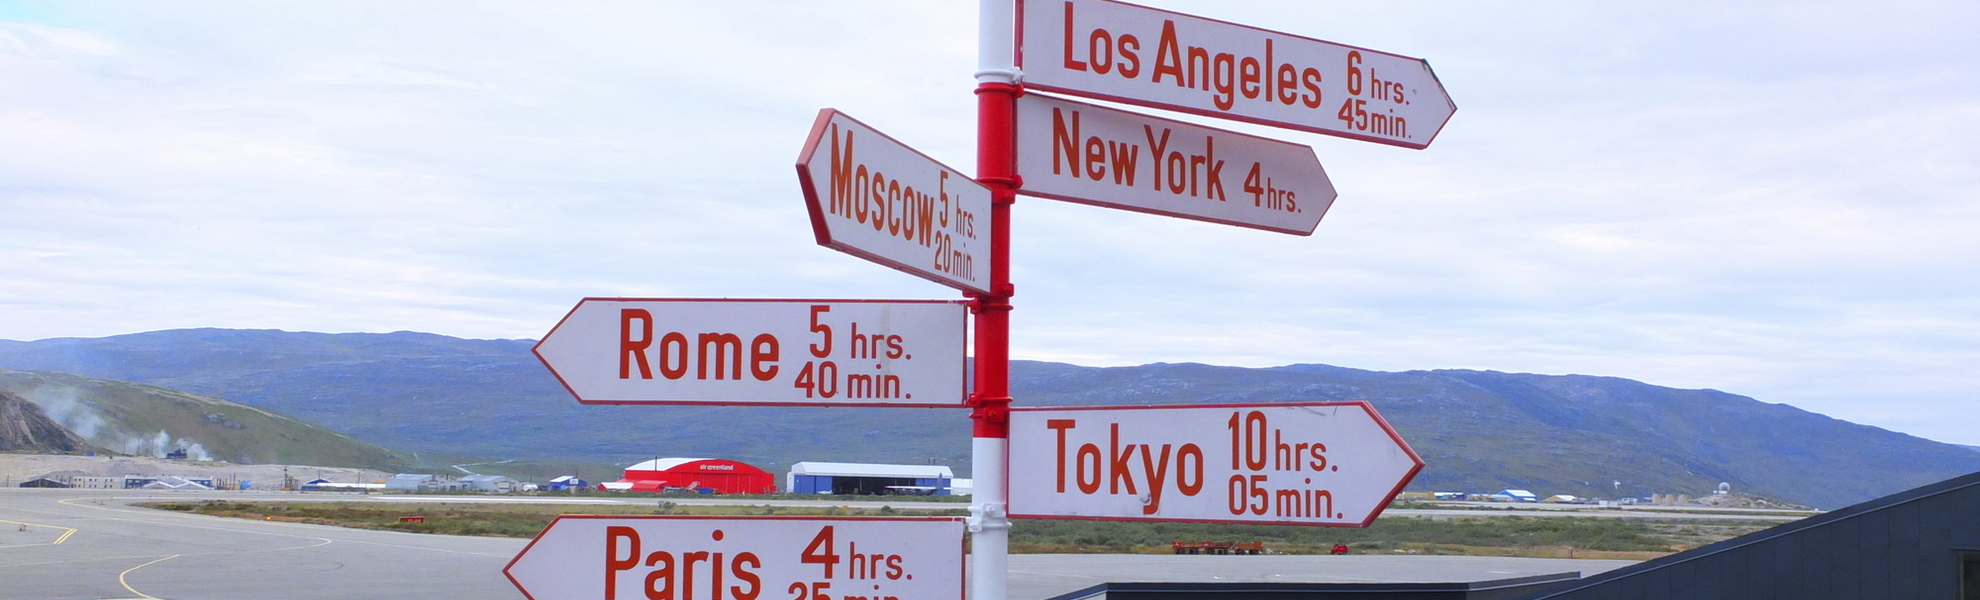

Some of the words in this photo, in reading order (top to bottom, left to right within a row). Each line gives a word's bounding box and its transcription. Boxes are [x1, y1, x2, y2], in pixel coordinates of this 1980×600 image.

[1064, 2, 1140, 79] Los
[1152, 20, 1322, 111] Angeles
[1347, 50, 1362, 96] 6
[1371, 67, 1410, 105] hrs.
[1337, 98, 1368, 131] 45
[1371, 108, 1411, 139] min.
[1053, 108, 1138, 187] New
[1144, 125, 1226, 202] York
[830, 122, 935, 248] Moscow
[939, 169, 949, 228] 5
[955, 194, 976, 240] hrs.
[1244, 162, 1264, 207] 4
[1267, 177, 1302, 213] hrs.
[934, 230, 951, 273] 20
[952, 242, 976, 282] min.
[619, 308, 780, 381] Rome
[809, 305, 832, 358] 5
[850, 322, 912, 360] hrs.
[794, 361, 837, 399] 40
[847, 363, 912, 400] min.
[1047, 419, 1204, 515] Tokyo
[1228, 410, 1267, 471] 10
[1275, 429, 1338, 472] hrs.
[1228, 474, 1269, 515] 05
[1275, 478, 1344, 519] min.
[605, 525, 761, 600] Paris
[801, 525, 840, 579] 4
[849, 542, 913, 580] hrs.
